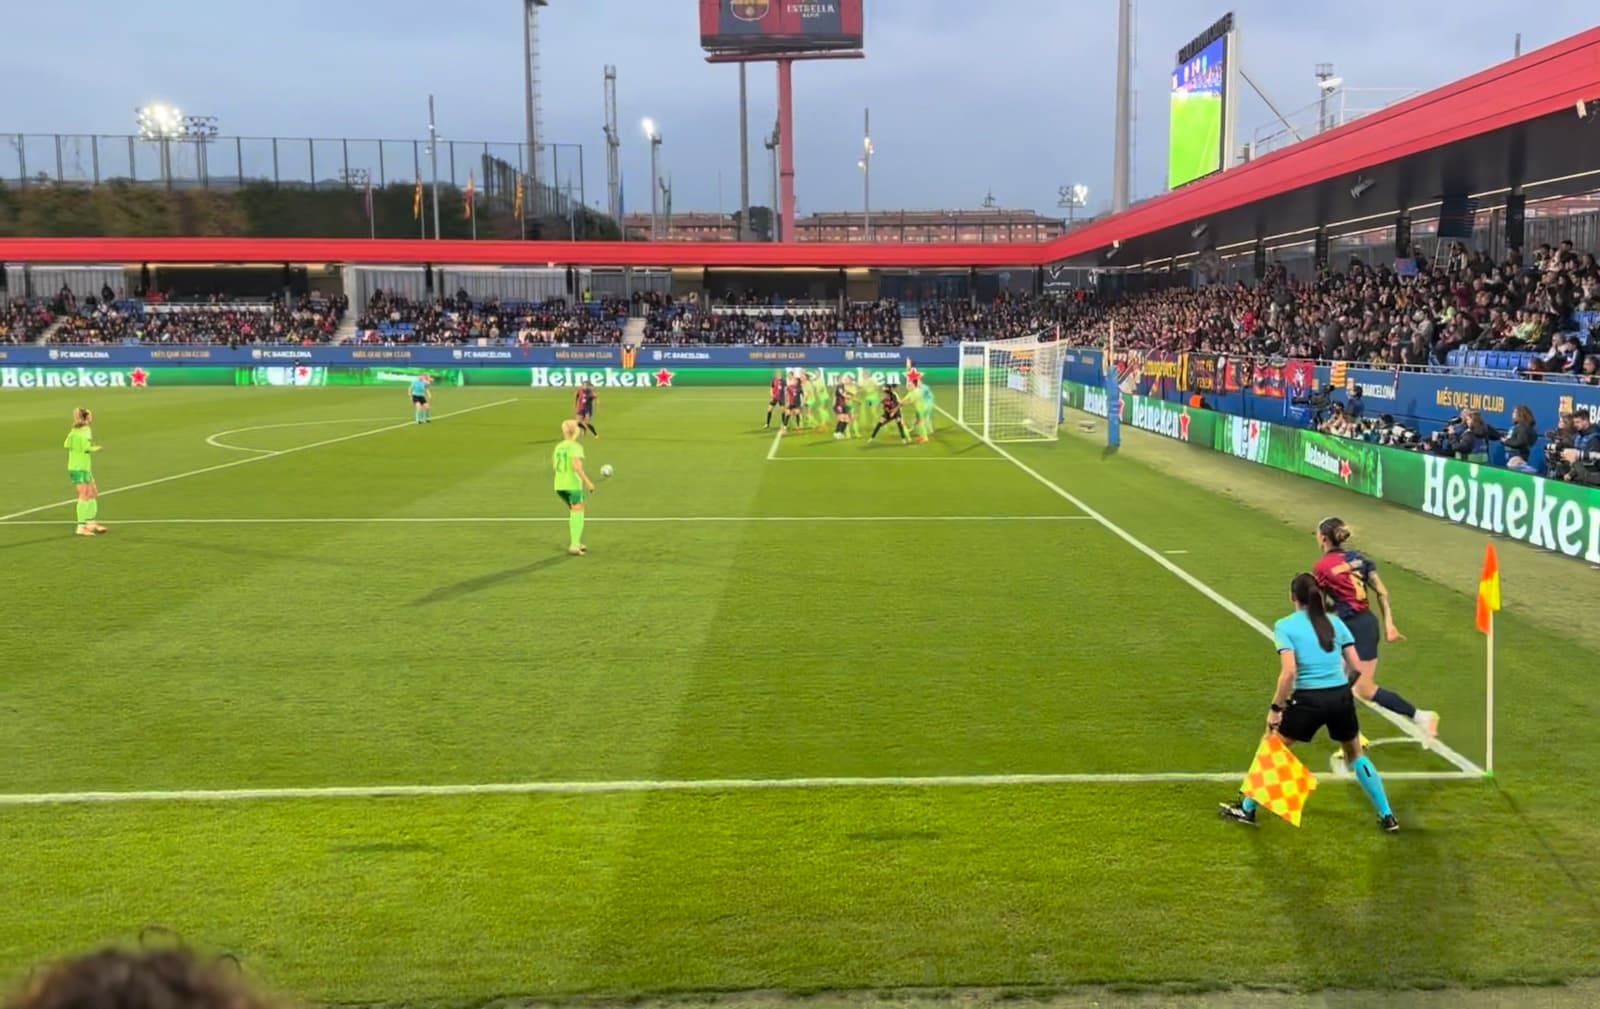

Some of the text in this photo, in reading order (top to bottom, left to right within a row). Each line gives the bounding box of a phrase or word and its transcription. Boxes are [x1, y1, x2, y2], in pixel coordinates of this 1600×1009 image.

[787, 4, 835, 13] ESTRELLA
[272, 351, 312, 359] BARCELONA
[1, 367, 127, 387] Heineken
[531, 367, 651, 387] Heineken
[1436, 386, 1505, 413] MÉS QUE UN CLUB
[1132, 395, 1179, 438] Heineken
[1304, 440, 1340, 475] Heineken
